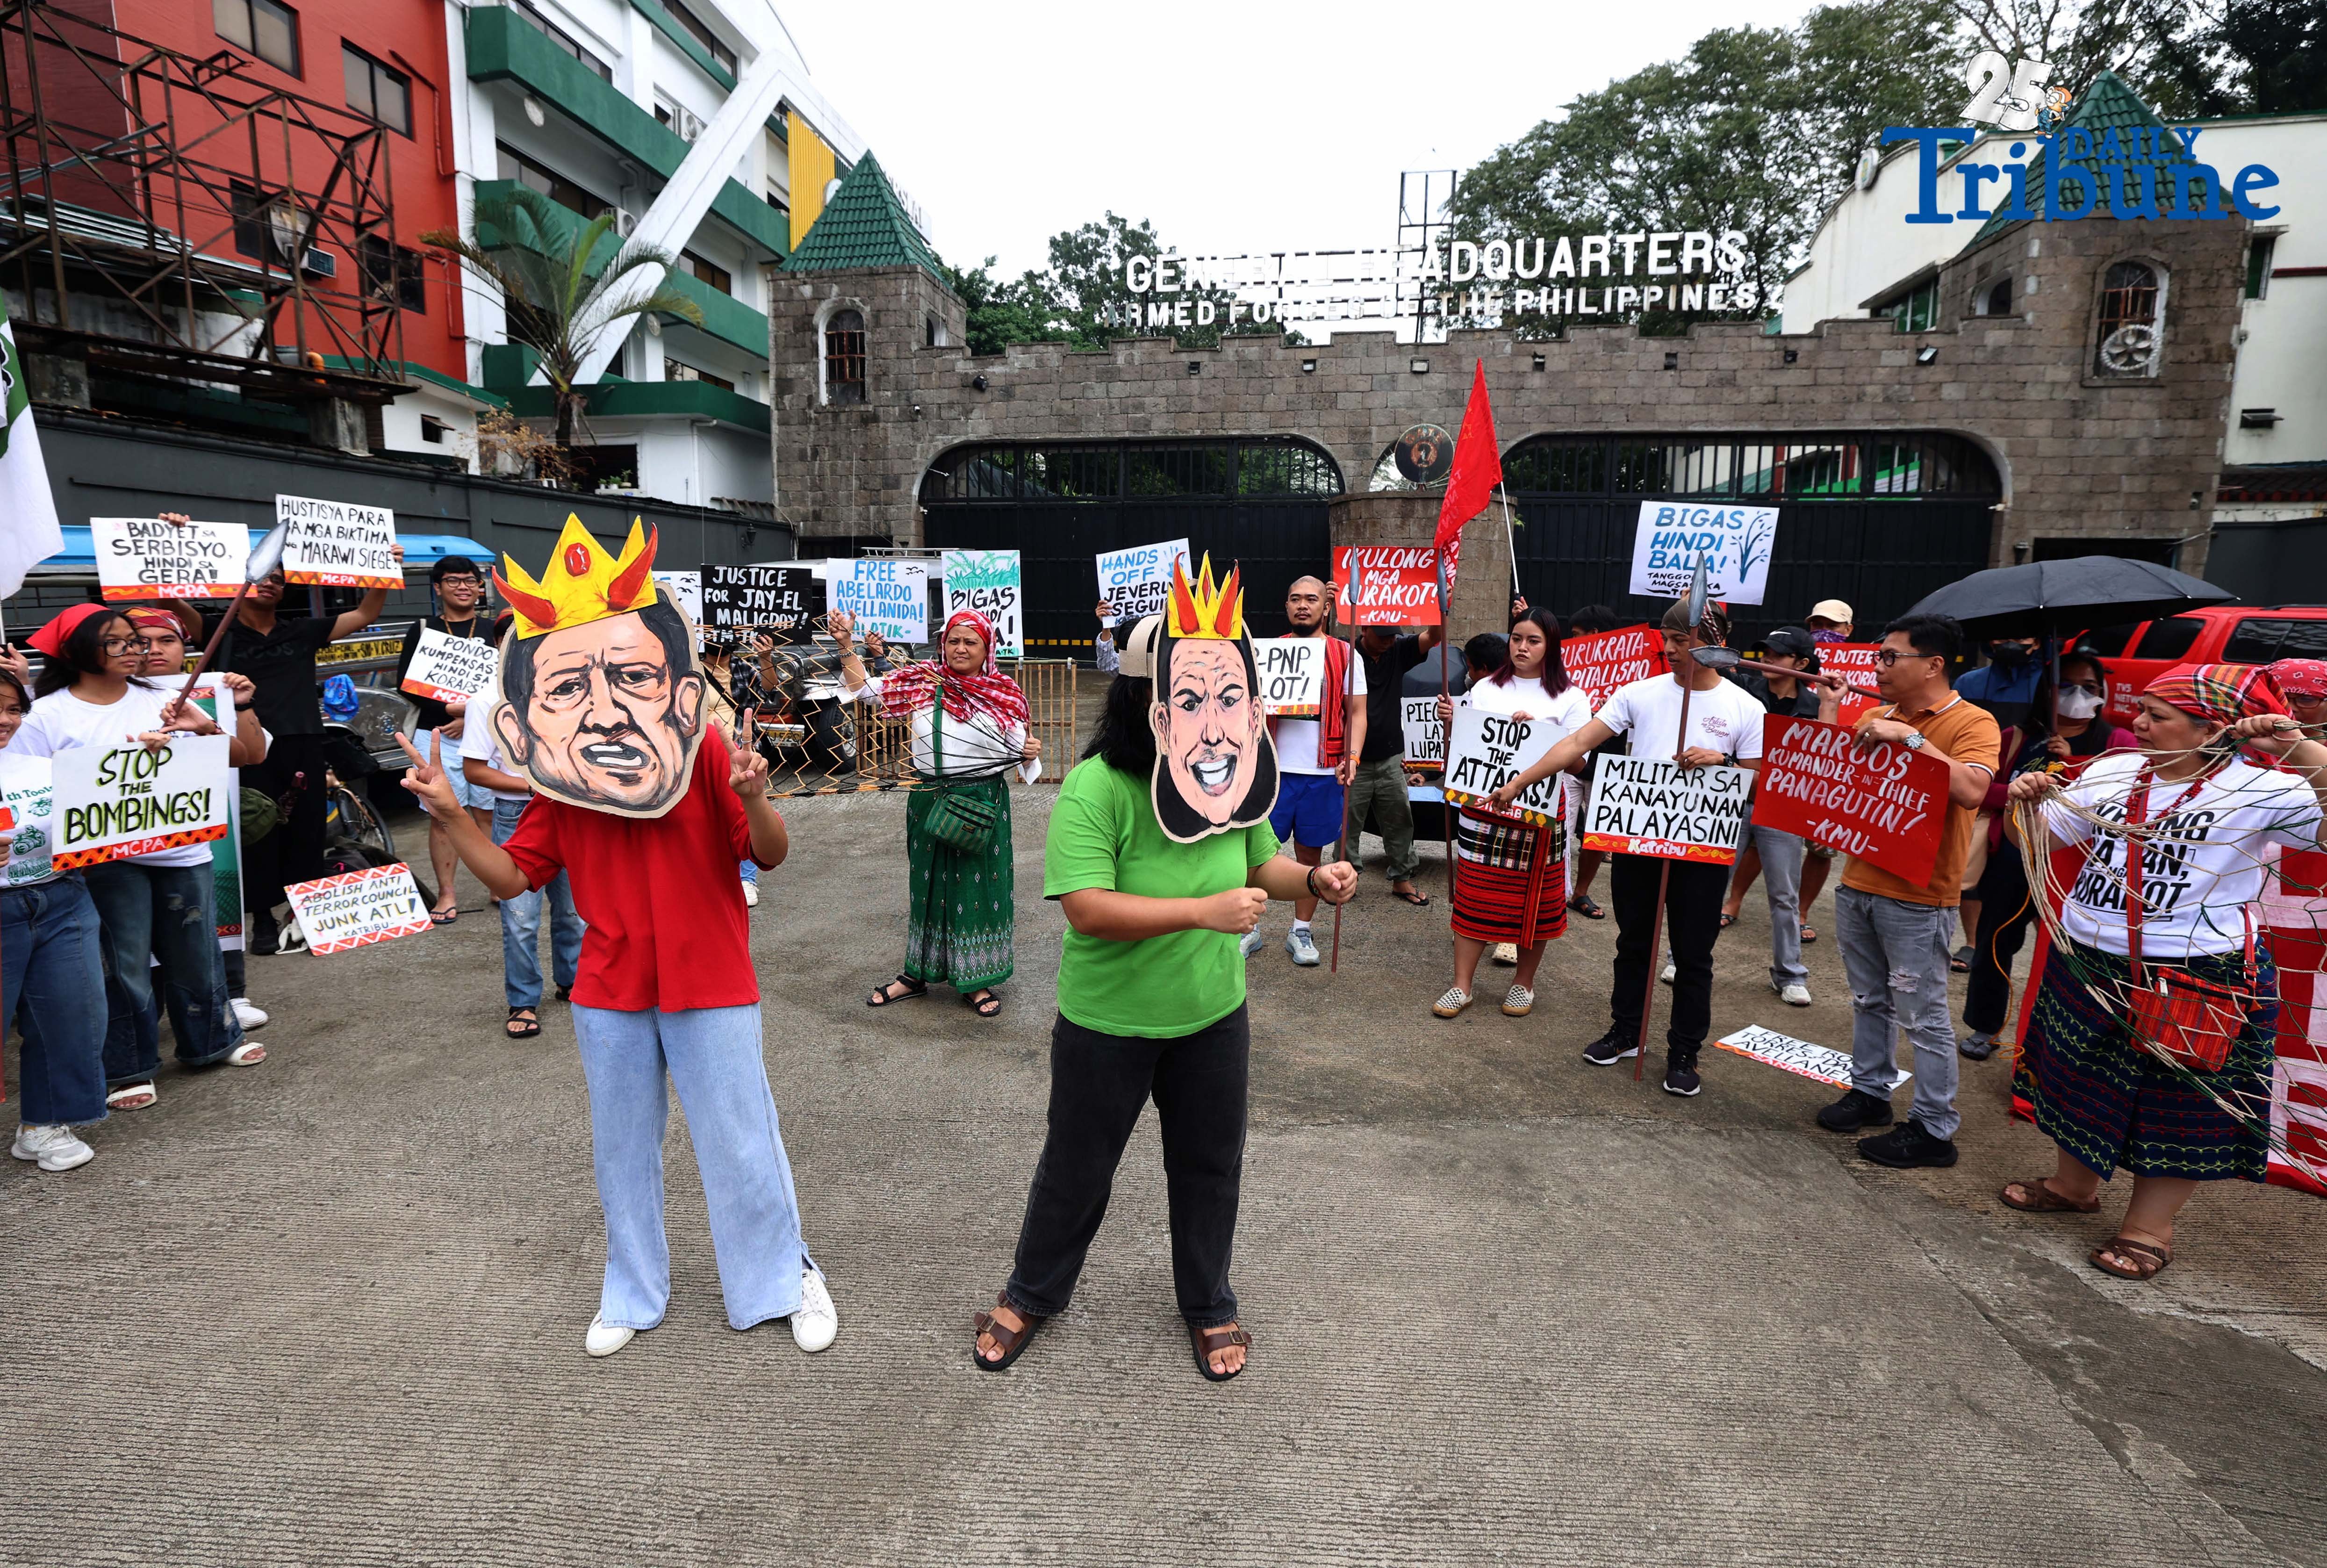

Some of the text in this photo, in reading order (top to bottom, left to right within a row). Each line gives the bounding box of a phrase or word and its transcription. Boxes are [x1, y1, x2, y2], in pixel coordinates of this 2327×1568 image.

[1354, 230, 1748, 284] HEADQUARTERS
[1104, 282, 1757, 327] ARMED FORCES OF THE PHILIPPINES
[281, 498, 386, 526] HUSTISYA PARA
[1655, 506, 1745, 530] BIGAS
[126, 522, 200, 539] BADYET
[304, 522, 332, 539] MGA
[337, 526, 389, 545] BIKTIMA
[1650, 531, 1724, 552] HINDI
[111, 539, 232, 559] SERBISYO,
[301, 541, 354, 565] MARAWI
[144, 557, 192, 568] HINDI
[854, 561, 896, 582] FREE
[1101, 549, 1158, 574] HANDS
[1647, 550, 1727, 574] BALA!
[138, 568, 218, 584] GERA!
[321, 573, 356, 585] MCPA
[712, 566, 787, 587] JUSTICE
[1111, 566, 1155, 585] OFF
[1365, 569, 1400, 585] MGA
[1651, 580, 1721, 590] MAGSAKA
[158, 584, 211, 598] MCPA
[704, 588, 803, 611] FOR JAY-EL
[836, 580, 912, 602] ABELARDO
[951, 586, 1015, 611] BIGAS
[837, 598, 924, 623] AVELLANIDA!
[1111, 598, 1168, 617] SEGUI
[1360, 610, 1408, 623] -KMU-
[443, 637, 493, 660] PONDO
[418, 645, 497, 676] KUMPENSAS
[424, 670, 484, 694] KORAPS
[434, 662, 489, 684] HINDI SA
[1566, 659, 1651, 689] PITALISMO
[432, 689, 471, 704] MCP
[1481, 717, 1531, 751] STOP
[1487, 747, 1515, 766] THE
[1781, 722, 1913, 781] MARCOS
[96, 746, 173, 787] STOP
[1604, 759, 1741, 794] MILITAR SA
[118, 781, 153, 797] THE
[1600, 782, 1746, 819] KANAYUNAN
[1765, 768, 1927, 836] PANAGUTIN!
[64, 788, 211, 845] BOMBINGS!
[1594, 805, 1739, 848] PALAYASIN!
[112, 837, 167, 859] MCPA
[1627, 838, 1687, 856] Katribu
[1806, 818, 1879, 855] -KMU-
[300, 876, 401, 906] ABOLISH ANTI
[304, 897, 359, 917] TERROR
[314, 898, 416, 932] JUNK ATL!
[1759, 1030, 1853, 1063] FREE RO
[1748, 1053, 1835, 1084] SANDUGO
